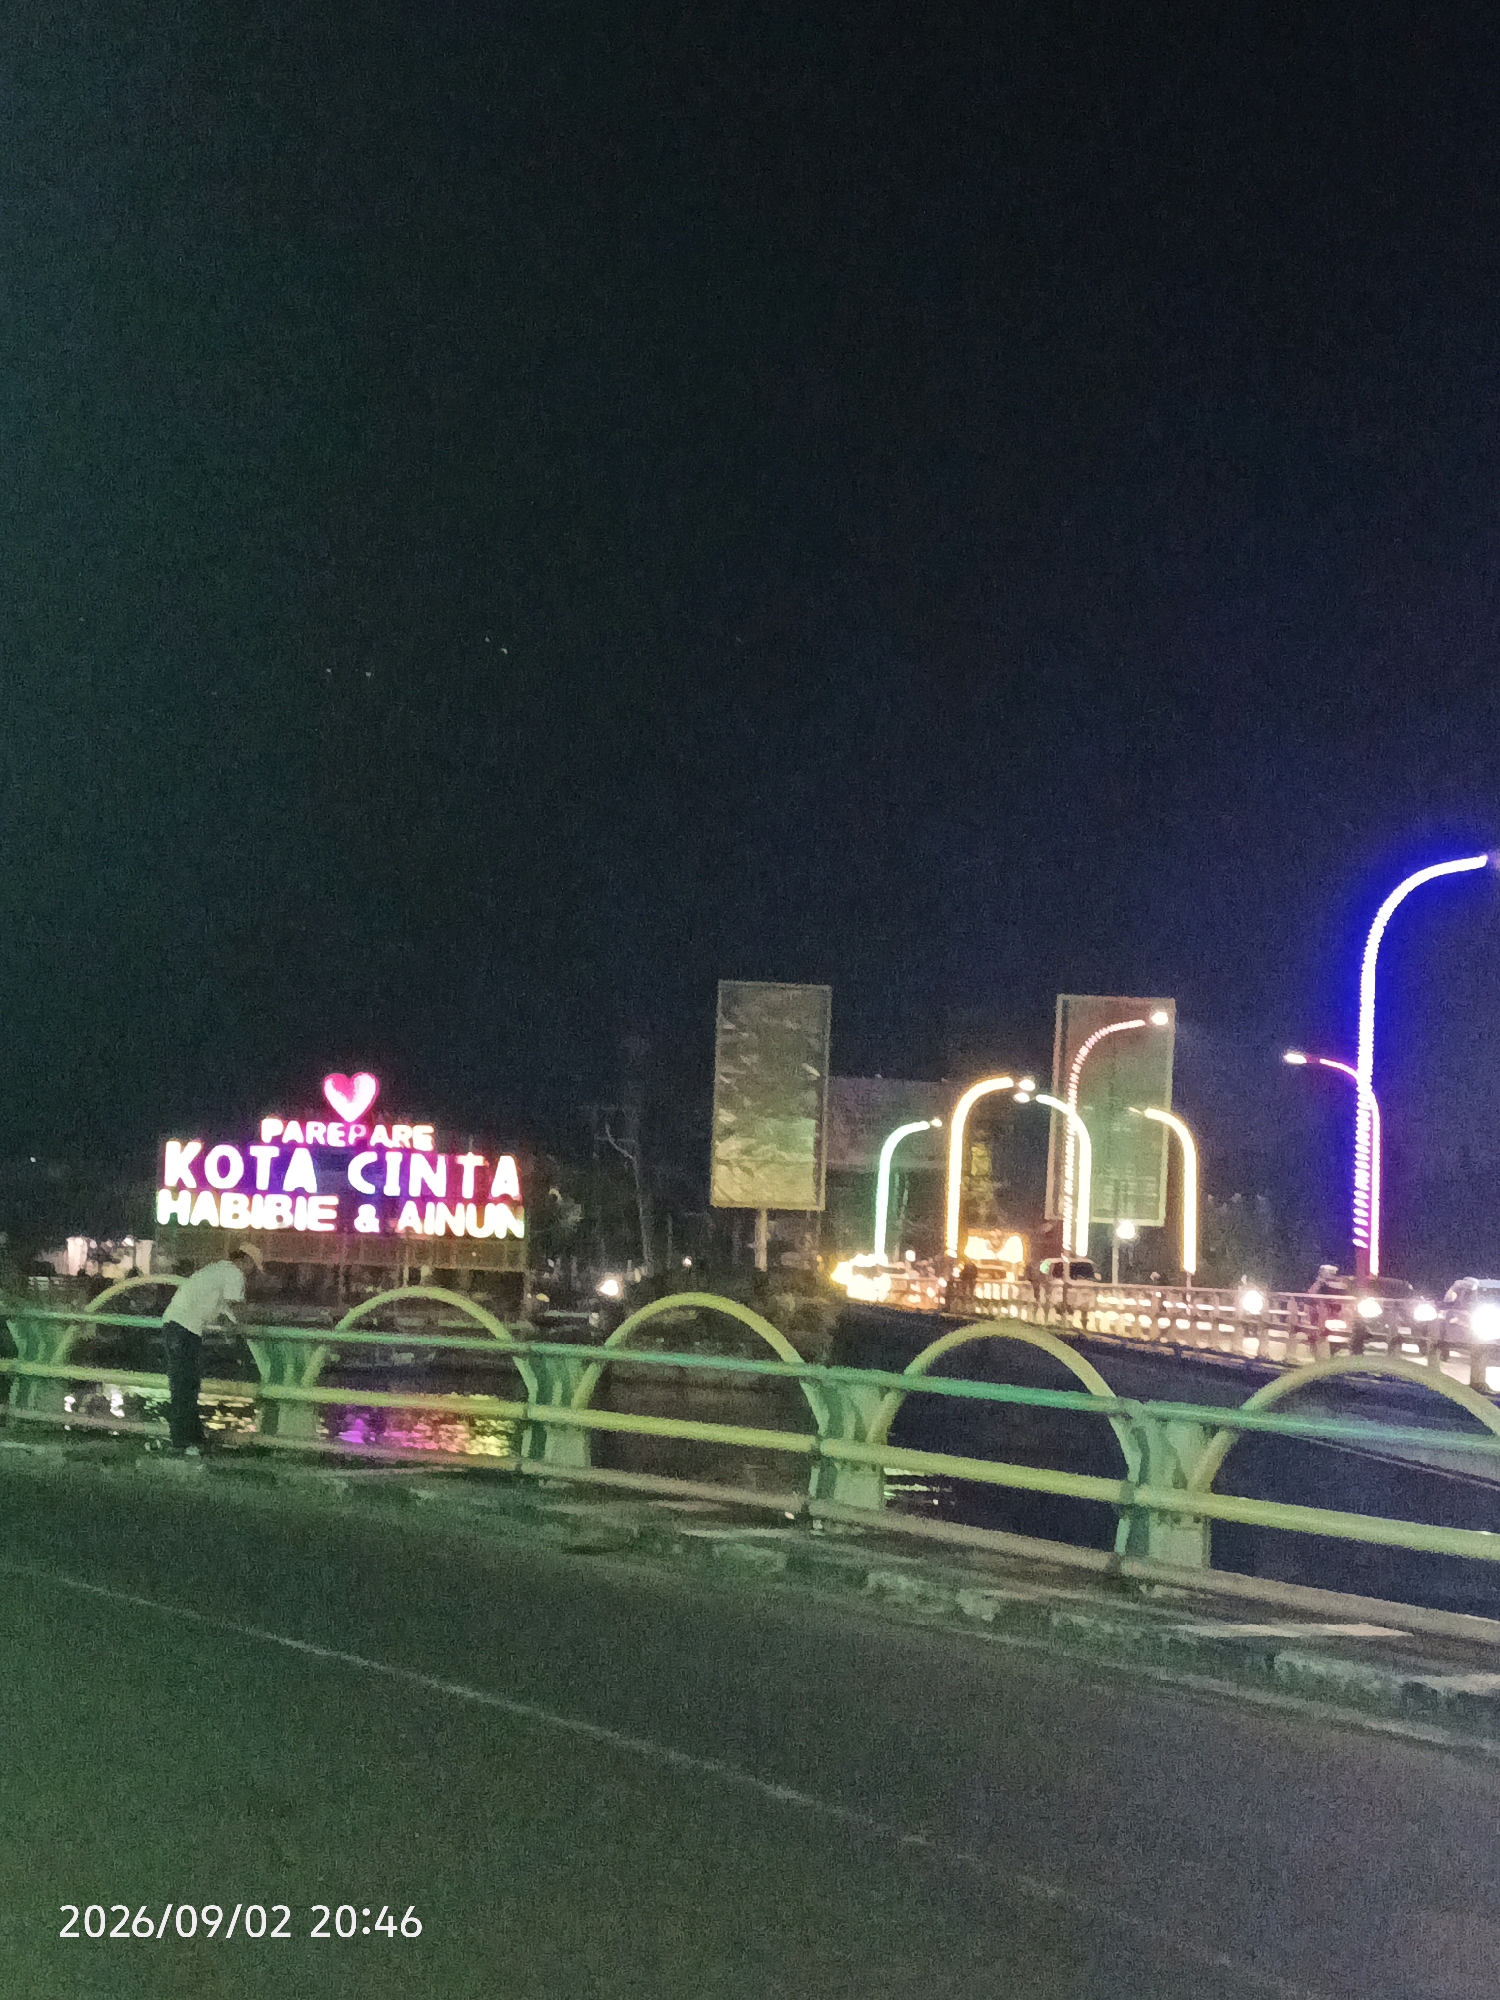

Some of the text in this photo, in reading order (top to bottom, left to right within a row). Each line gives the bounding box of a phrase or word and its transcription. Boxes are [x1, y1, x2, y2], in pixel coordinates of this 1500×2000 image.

[260, 1117, 435, 1152] PAREPARE
[163, 1139, 522, 1200] KOTA CINTA
[156, 1188, 526, 1240] HABIBIE & AINUN
